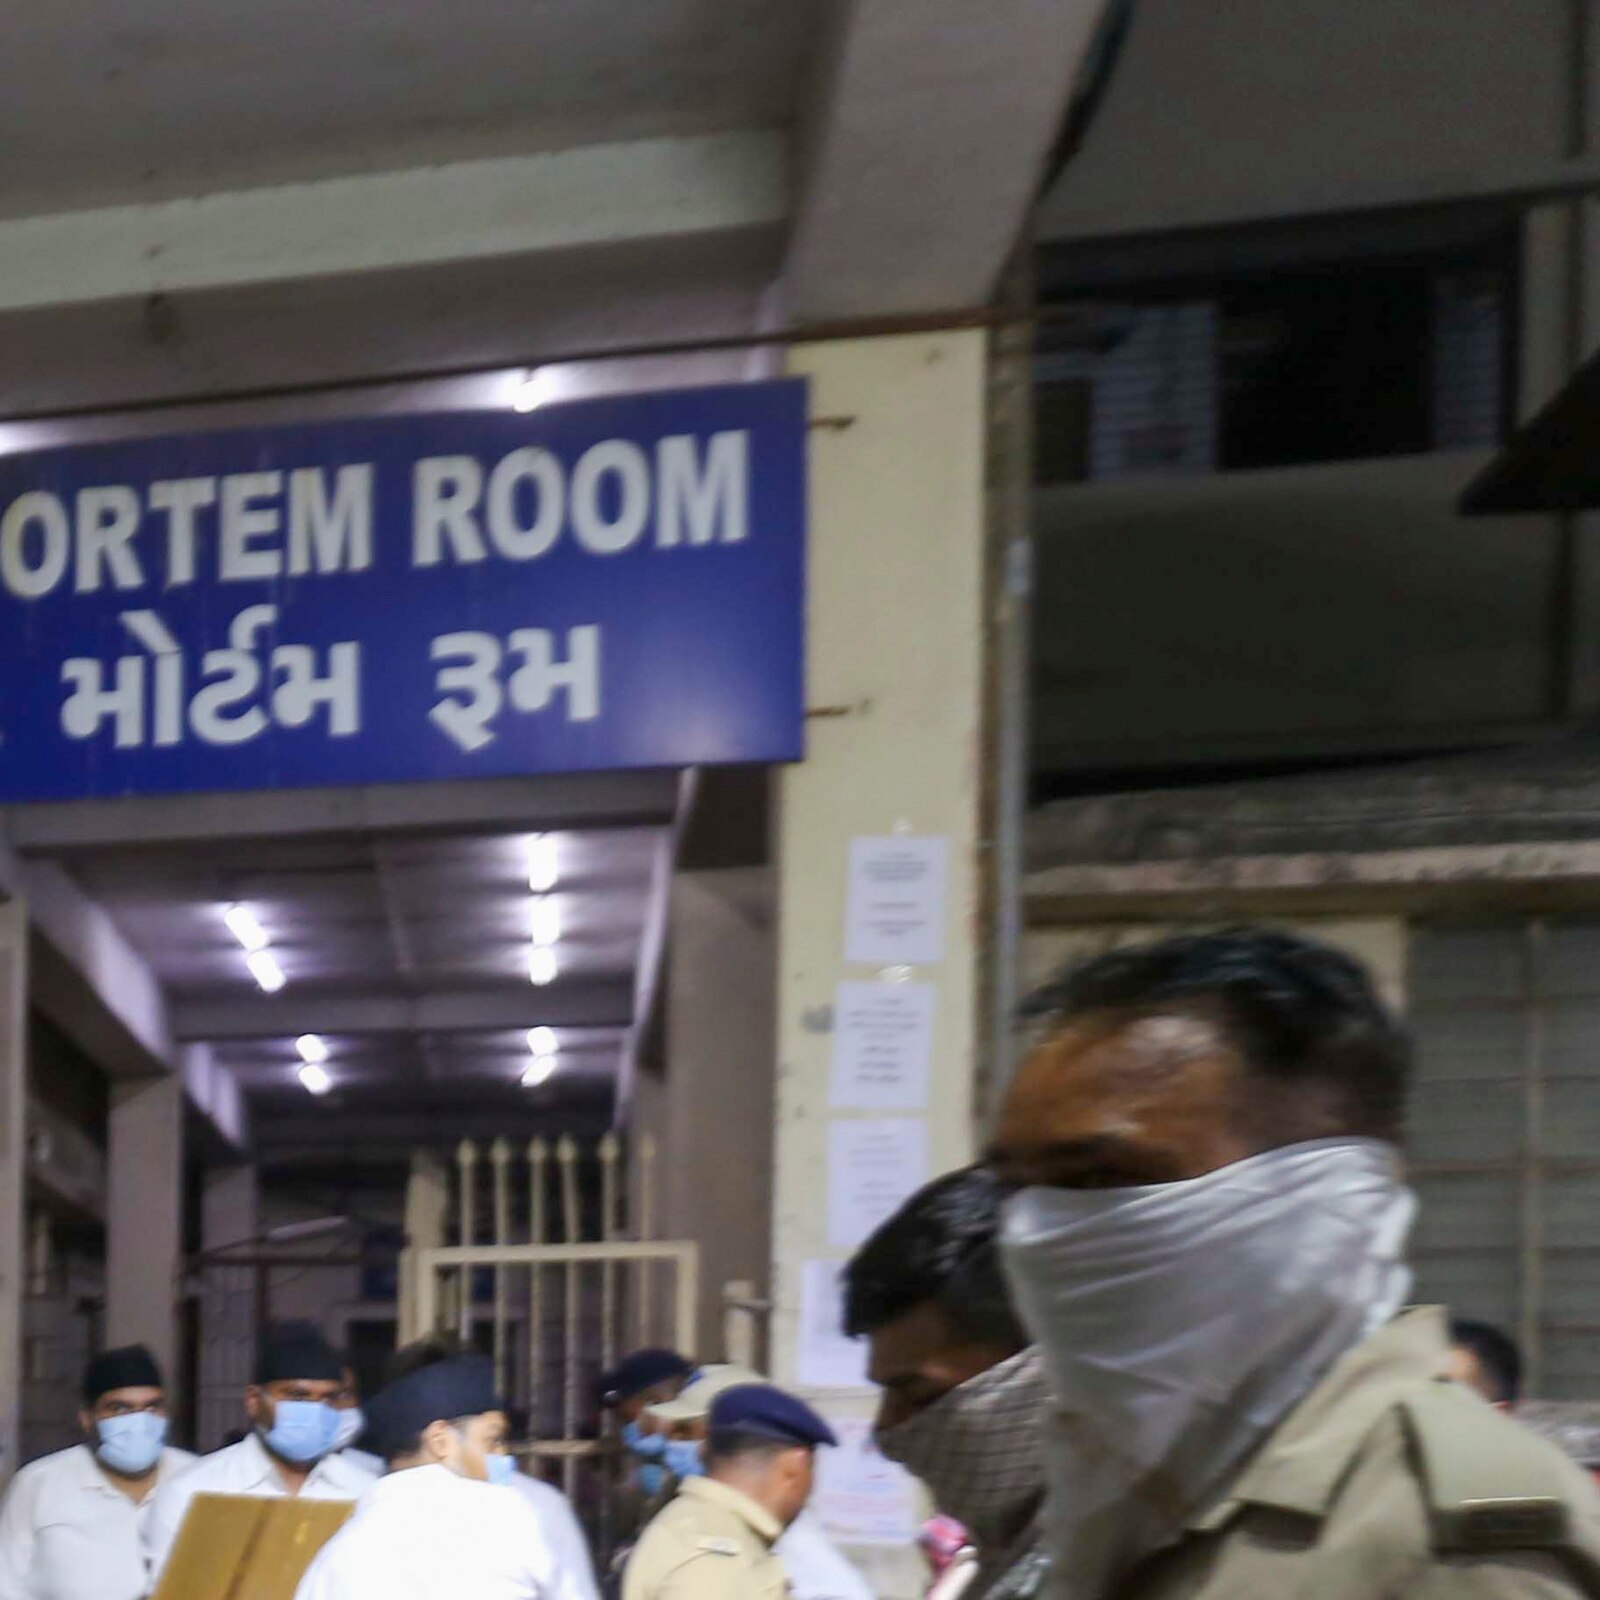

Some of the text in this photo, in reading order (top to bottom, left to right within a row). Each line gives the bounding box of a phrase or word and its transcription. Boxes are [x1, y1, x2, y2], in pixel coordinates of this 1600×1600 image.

[411, 428, 749, 568] ROOM
[59, 603, 361, 749] મોર્ટમ
[428, 623, 602, 753] રૂમ
